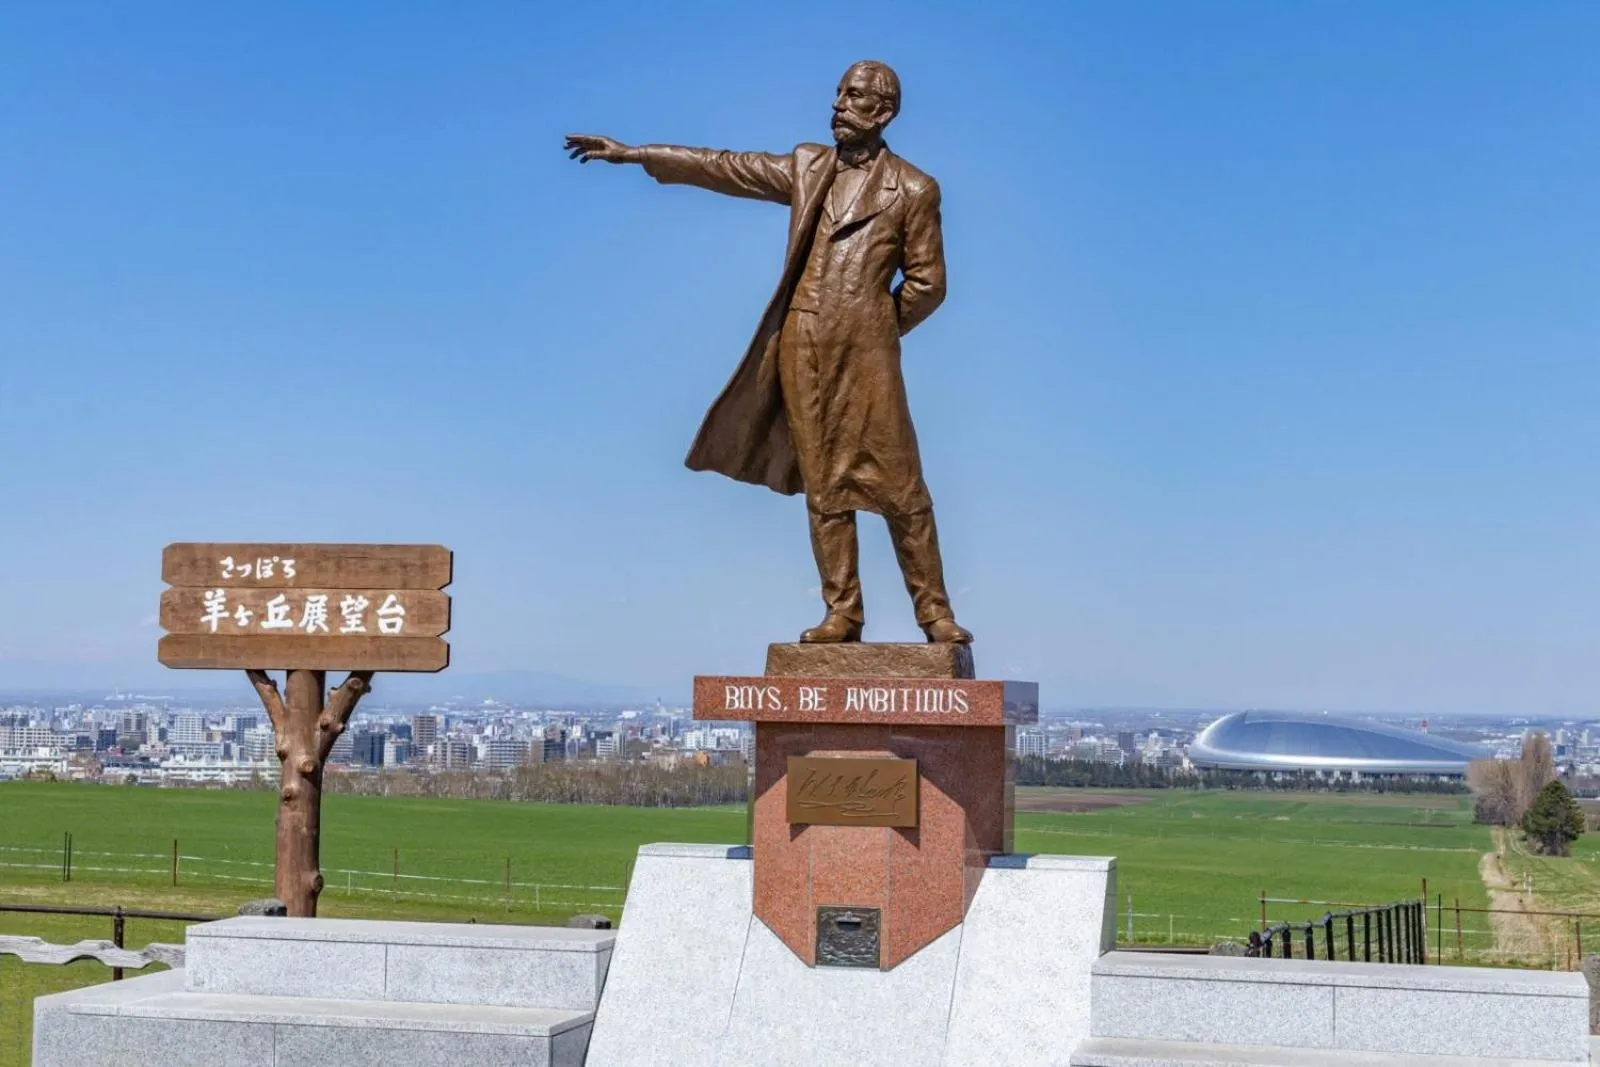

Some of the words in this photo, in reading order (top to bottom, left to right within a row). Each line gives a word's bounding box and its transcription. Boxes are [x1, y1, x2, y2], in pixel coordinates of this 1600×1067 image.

[725, 685, 788, 712] BOYS,
[799, 687, 828, 711] BE
[845, 687, 969, 714] AMBITIOUS
